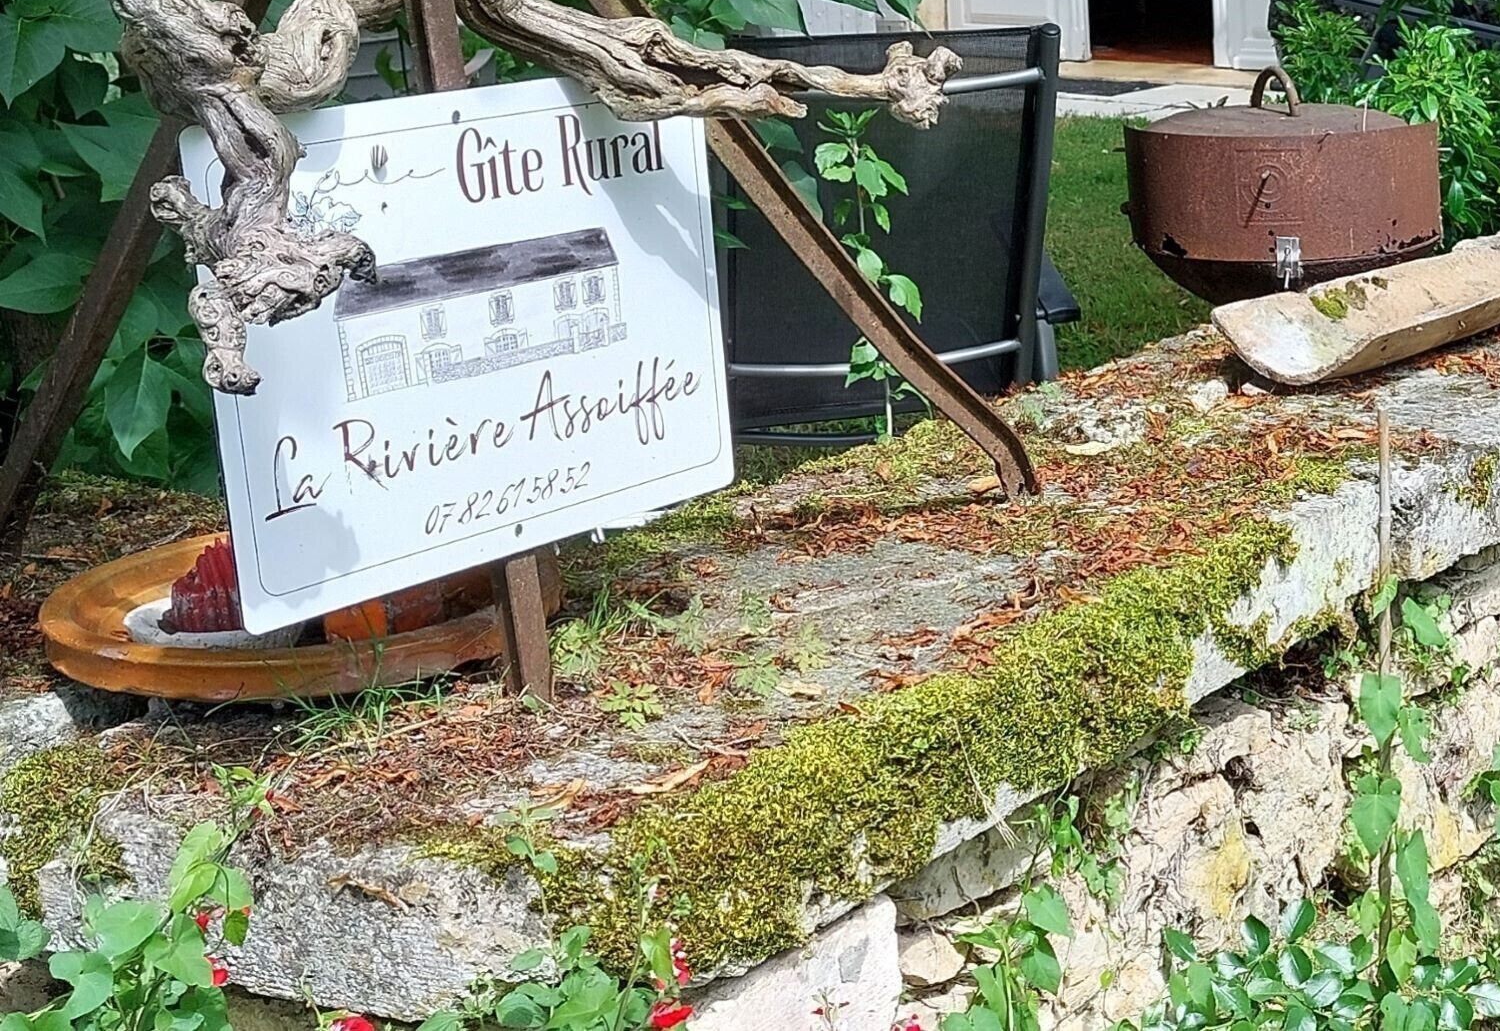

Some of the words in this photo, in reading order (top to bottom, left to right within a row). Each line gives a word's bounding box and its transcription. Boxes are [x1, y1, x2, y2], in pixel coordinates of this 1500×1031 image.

[456, 126, 545, 204] Gîte
[554, 113, 665, 196] Rural
[264, 435, 332, 522] La
[332, 416, 517, 491] Rivière
[520, 356, 702, 446] Assoiffée
